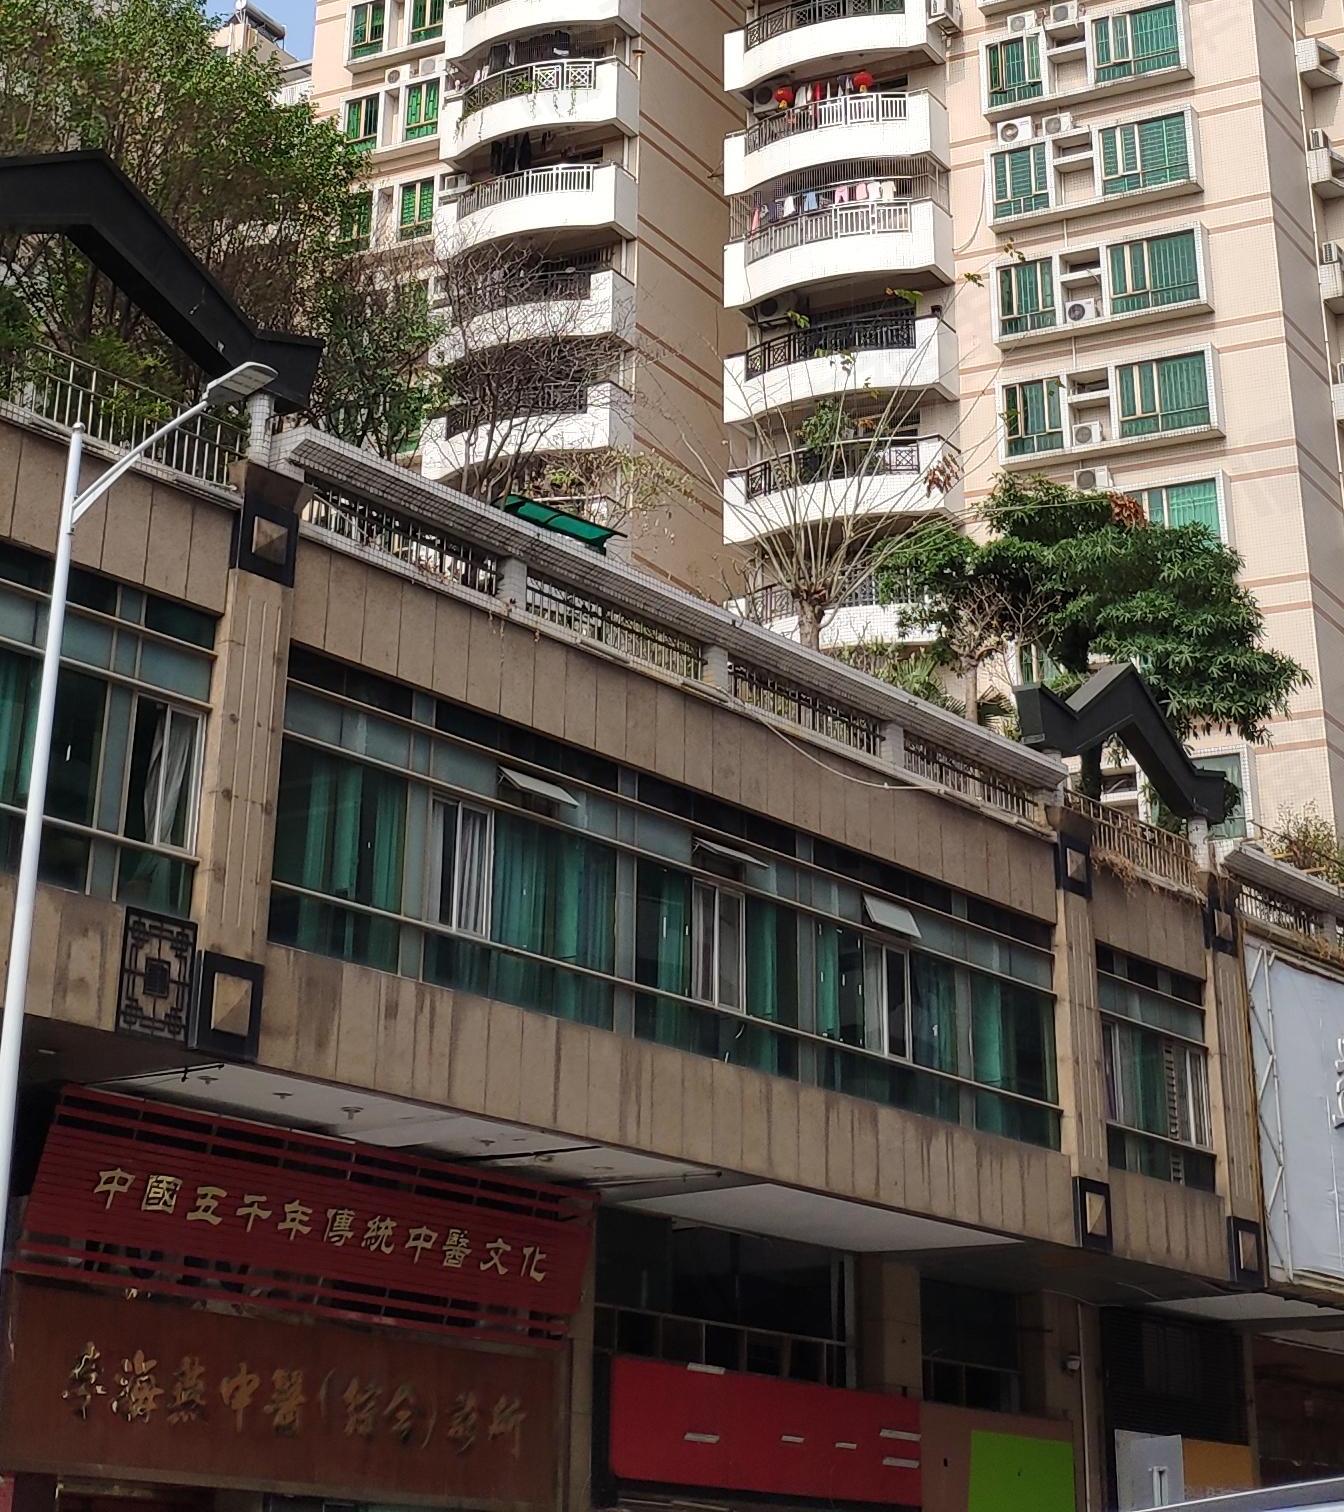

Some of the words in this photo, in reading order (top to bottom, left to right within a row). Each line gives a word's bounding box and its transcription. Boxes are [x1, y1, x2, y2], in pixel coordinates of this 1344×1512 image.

[93, 1167, 548, 1282] 中國五千年傳統中醫文化
